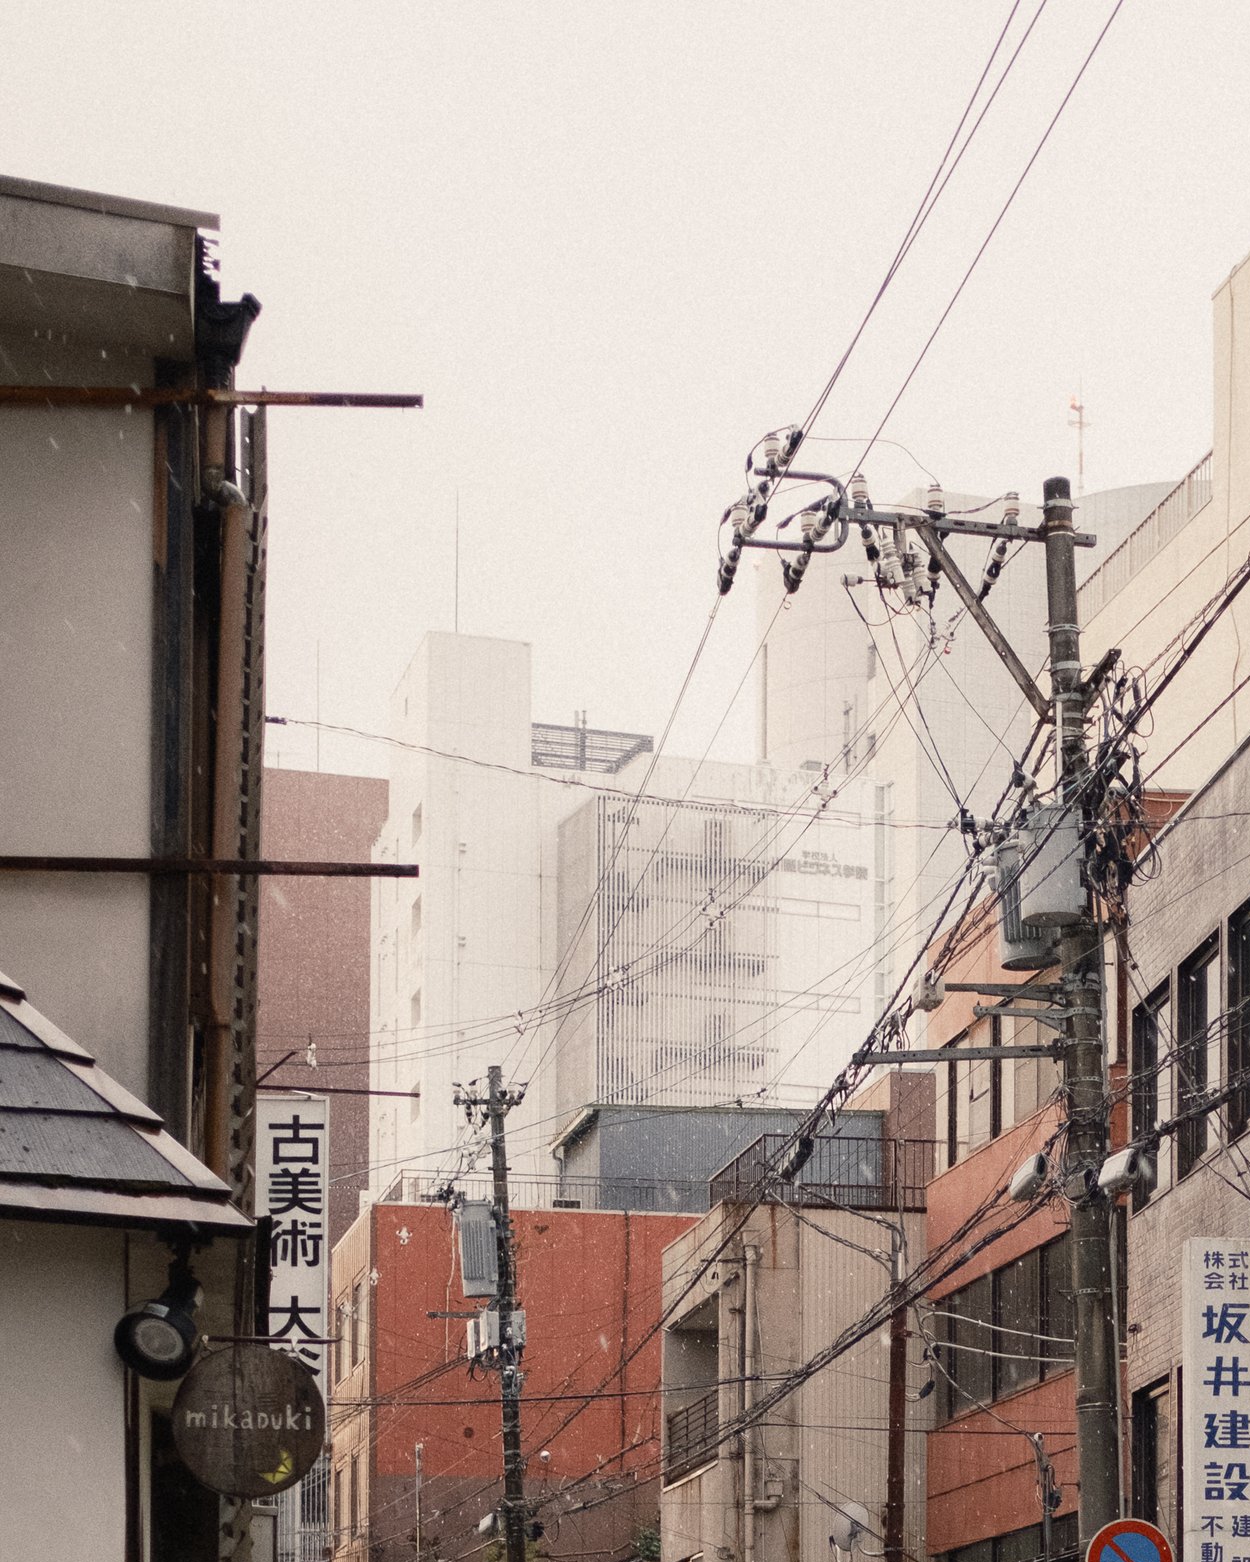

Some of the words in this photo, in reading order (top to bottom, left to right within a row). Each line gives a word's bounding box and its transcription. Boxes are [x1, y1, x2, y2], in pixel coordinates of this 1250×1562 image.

[268, 1114, 325, 1267] 古美術
[1203, 1250, 1249, 1270] 株式
[1203, 1271, 1249, 1290] 会社
[1202, 1303, 1250, 1501] 坂井建設
